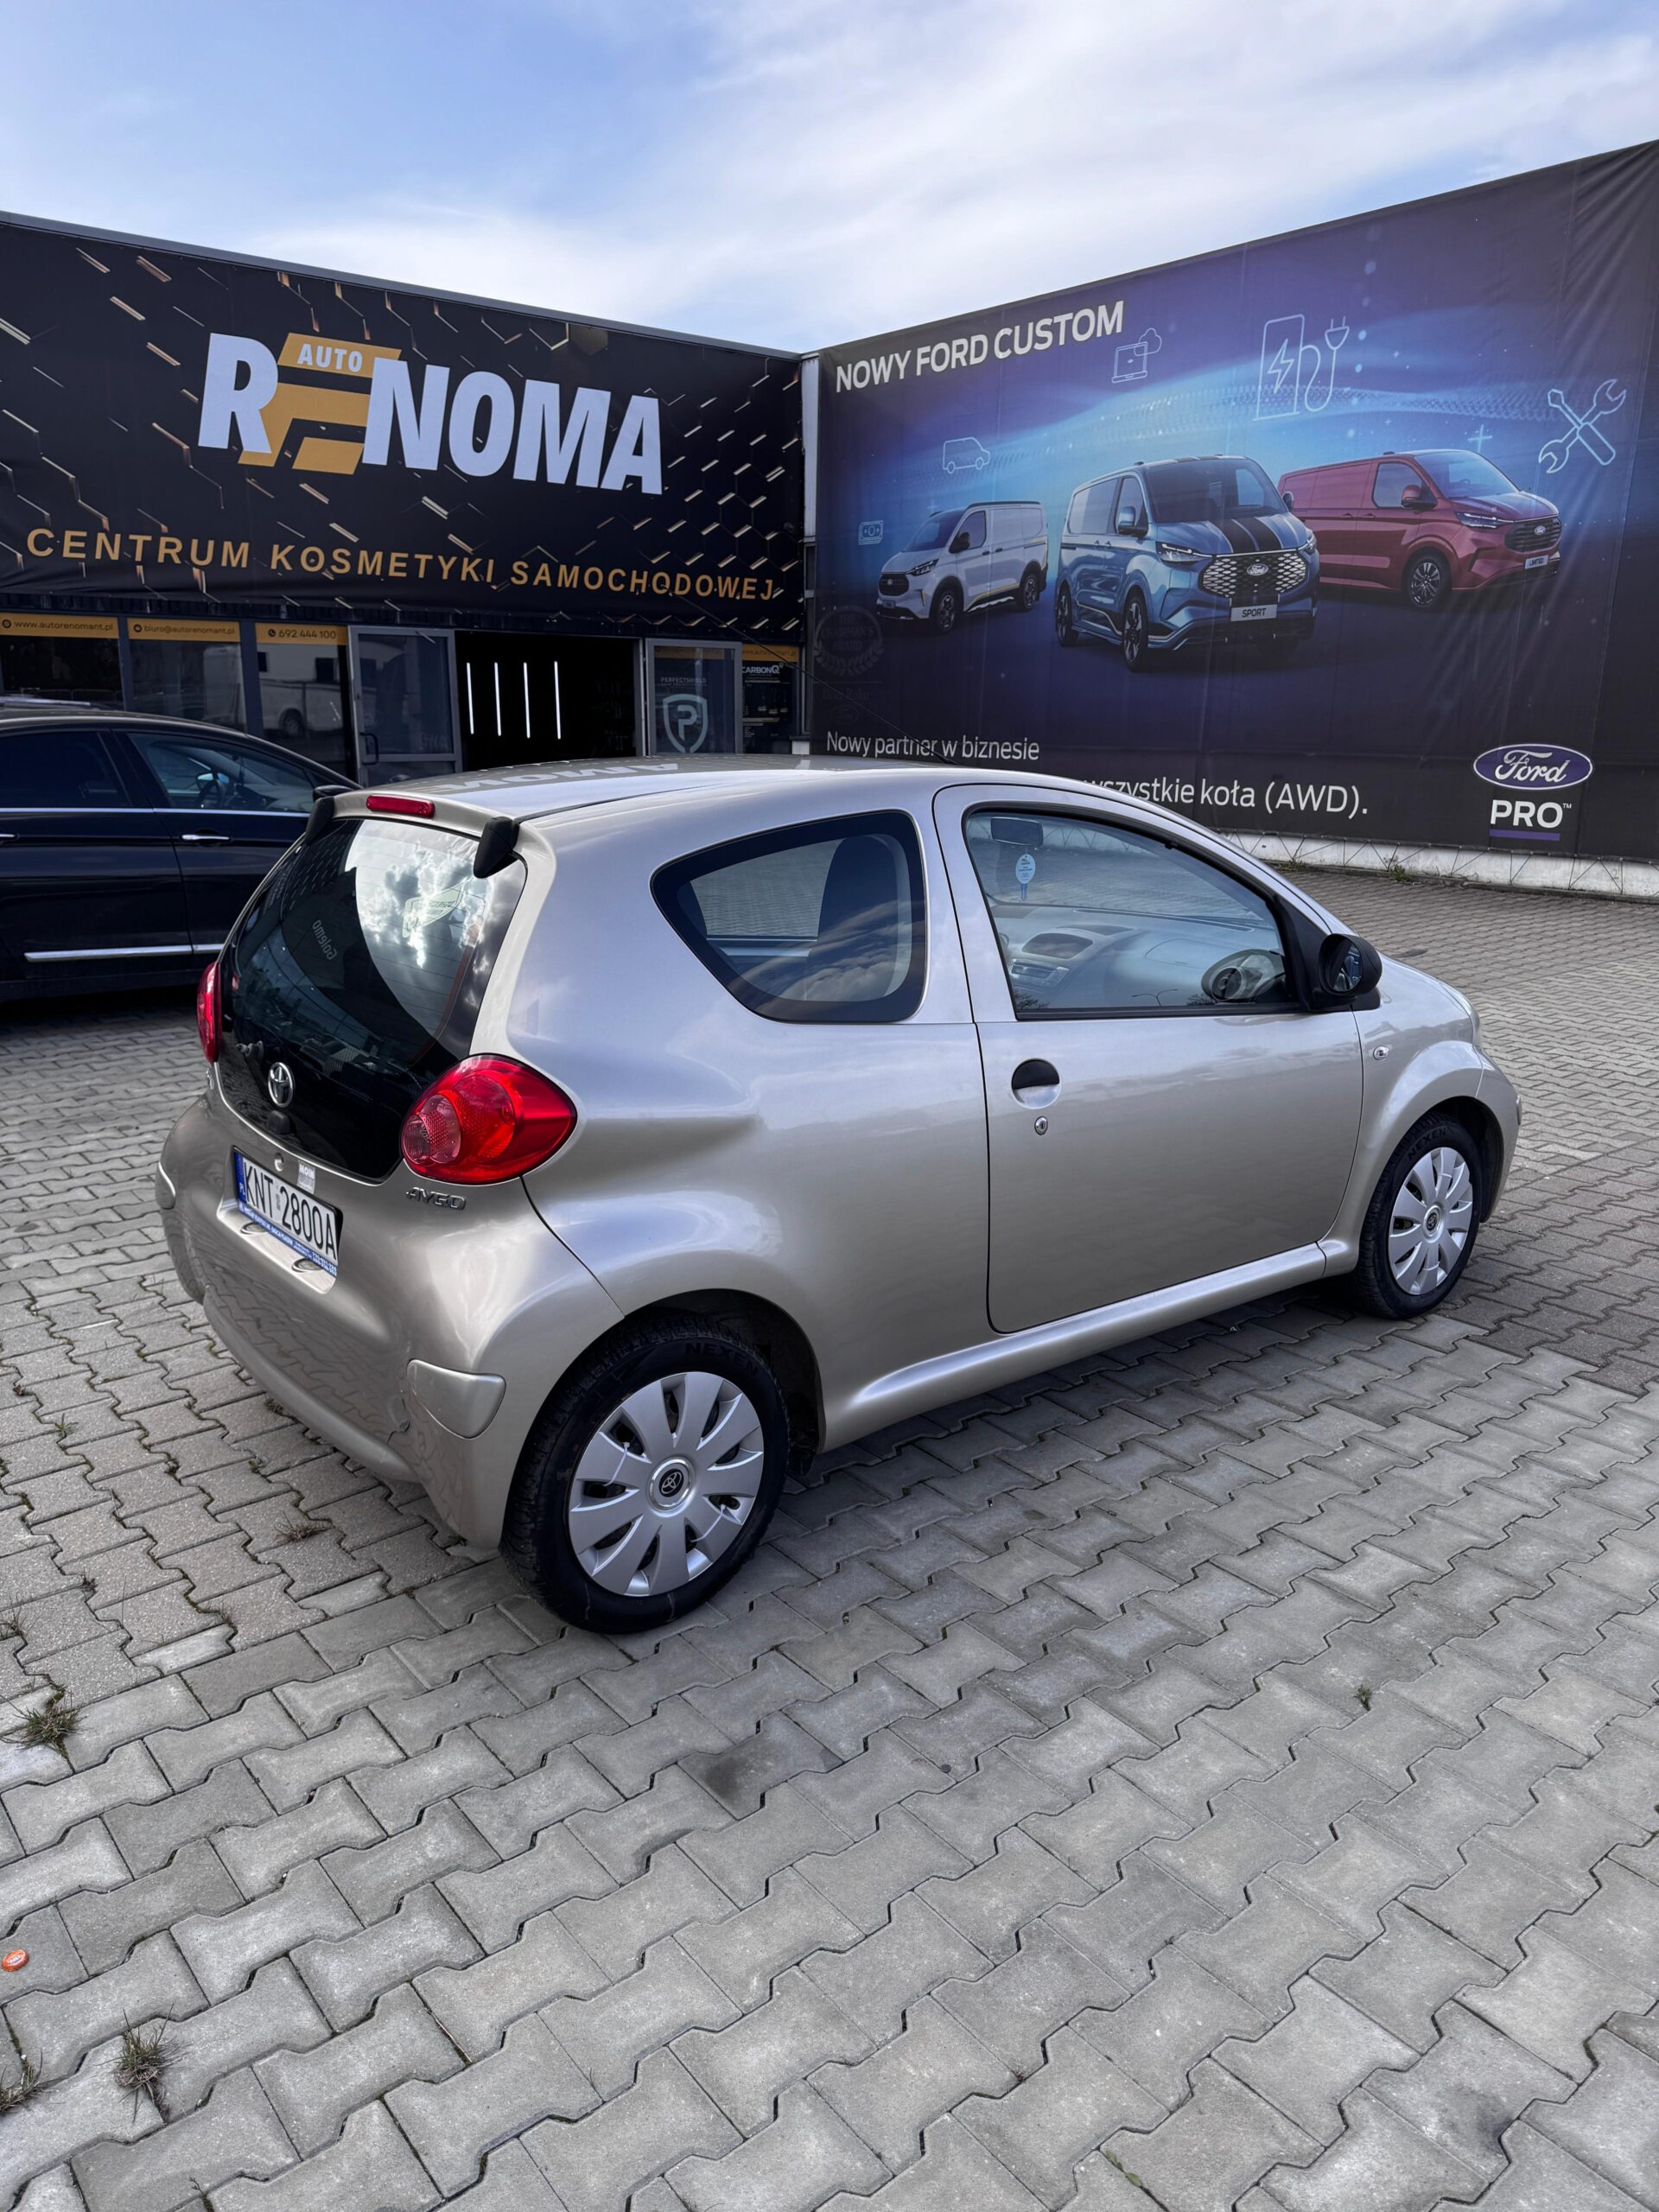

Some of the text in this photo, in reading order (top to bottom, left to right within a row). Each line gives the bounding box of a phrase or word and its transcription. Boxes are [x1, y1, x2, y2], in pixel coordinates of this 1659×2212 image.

[296, 343, 364, 373] AUTO
[836, 301, 1124, 393] NOWY FORD CUSTOM
[27, 528, 774, 601] CENTRUM KOSMETYKI SAMOCHODOWEJ
[1242, 607, 1267, 618] SPORT
[279, 629, 297, 639] 692
[320, 631, 337, 639] 100
[826, 731, 1040, 760] Nowy partner w biznesie
[1494, 749, 1571, 783] Ford
[1083, 777, 1369, 820] zystkie koła (AWD).
[1490, 799, 1563, 829] PRO
[244, 1161, 273, 1218] KNT
[279, 1185, 337, 1261] 2800A
